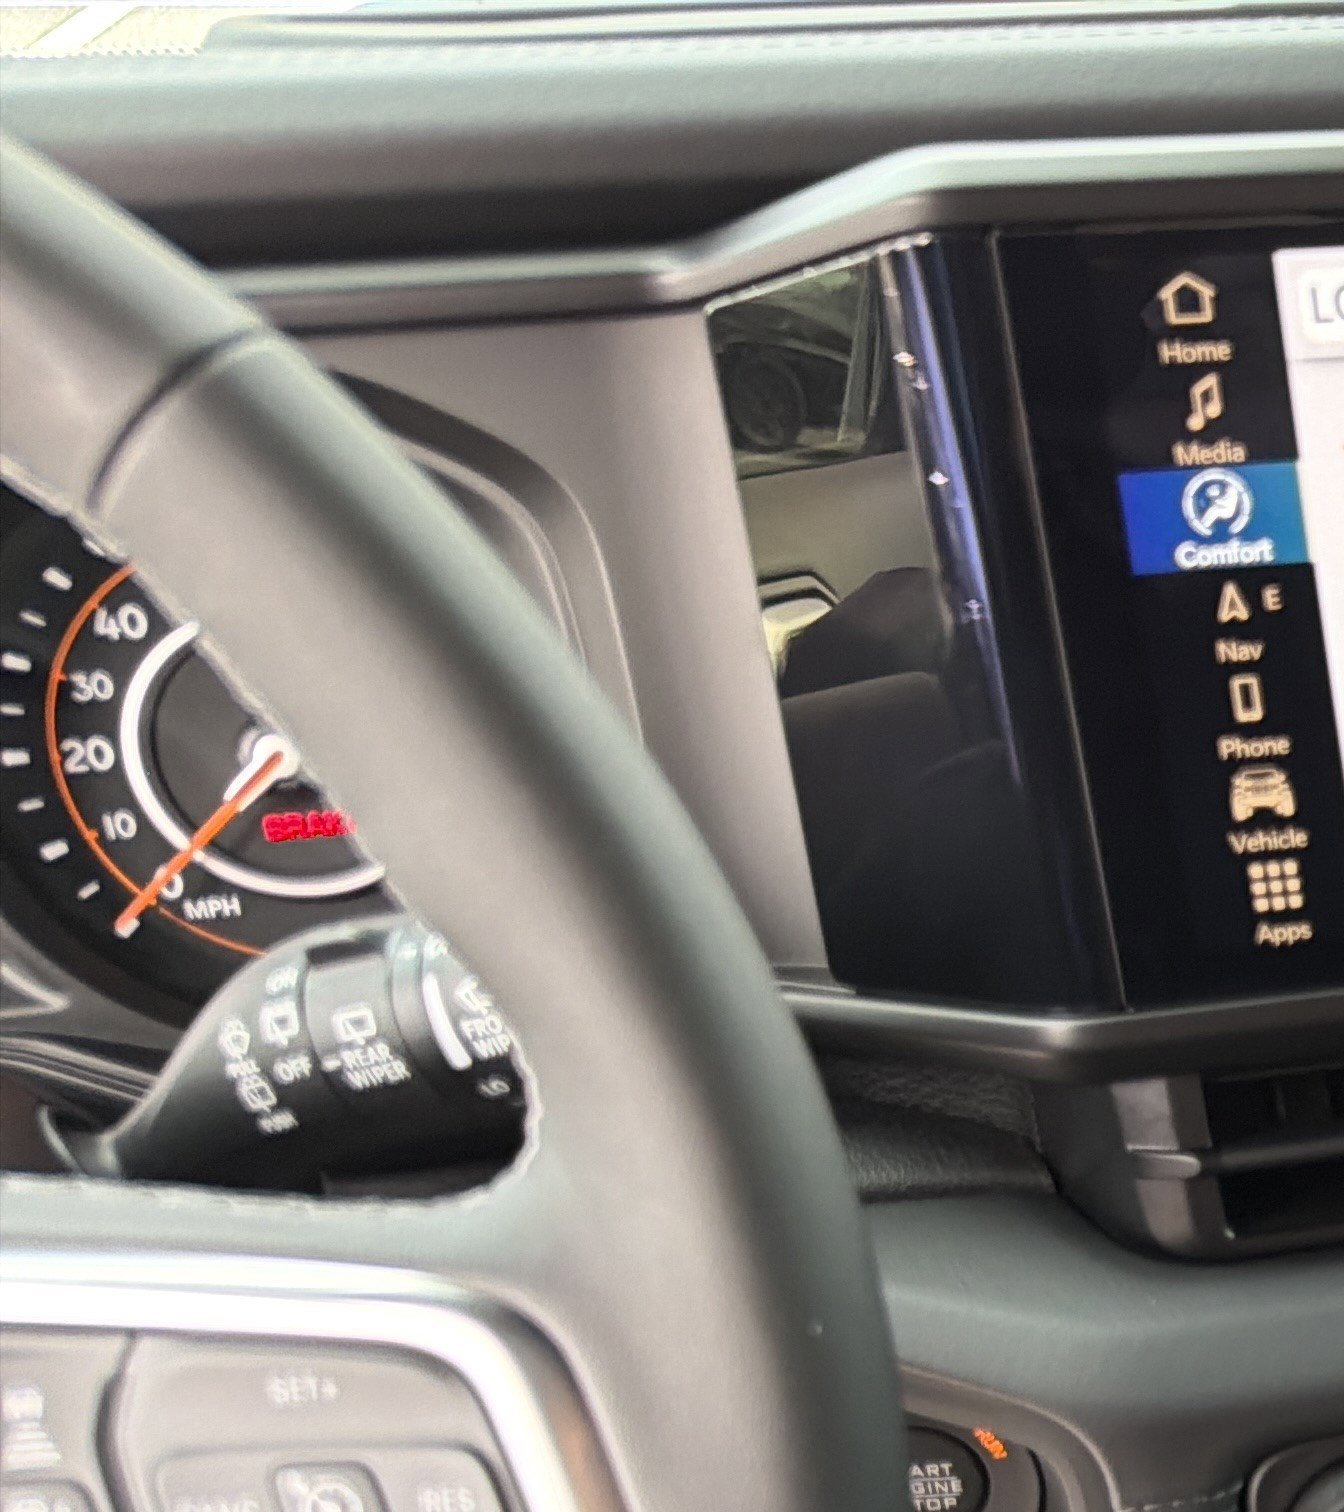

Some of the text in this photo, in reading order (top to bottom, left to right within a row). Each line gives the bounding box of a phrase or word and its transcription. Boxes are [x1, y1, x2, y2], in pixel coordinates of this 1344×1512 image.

[1158, 339, 1233, 366] Home
[1173, 438, 1247, 467] Media
[1174, 538, 1276, 570] Comfort
[1261, 582, 1283, 612] E
[93, 601, 149, 641] 40
[1214, 638, 1265, 664] Nav
[69, 669, 115, 703] 30
[60, 735, 115, 774] 20
[1217, 735, 1291, 761] Phone
[102, 808, 137, 840] 10
[262, 809, 357, 843] BRAK
[1227, 828, 1310, 854] Vehicle
[182, 893, 243, 921] MPH
[1255, 921, 1313, 947] Apps
[272, 1053, 313, 1084] OFF
[339, 1040, 395, 1067] REAR
[342, 1059, 412, 1089] WIPER
